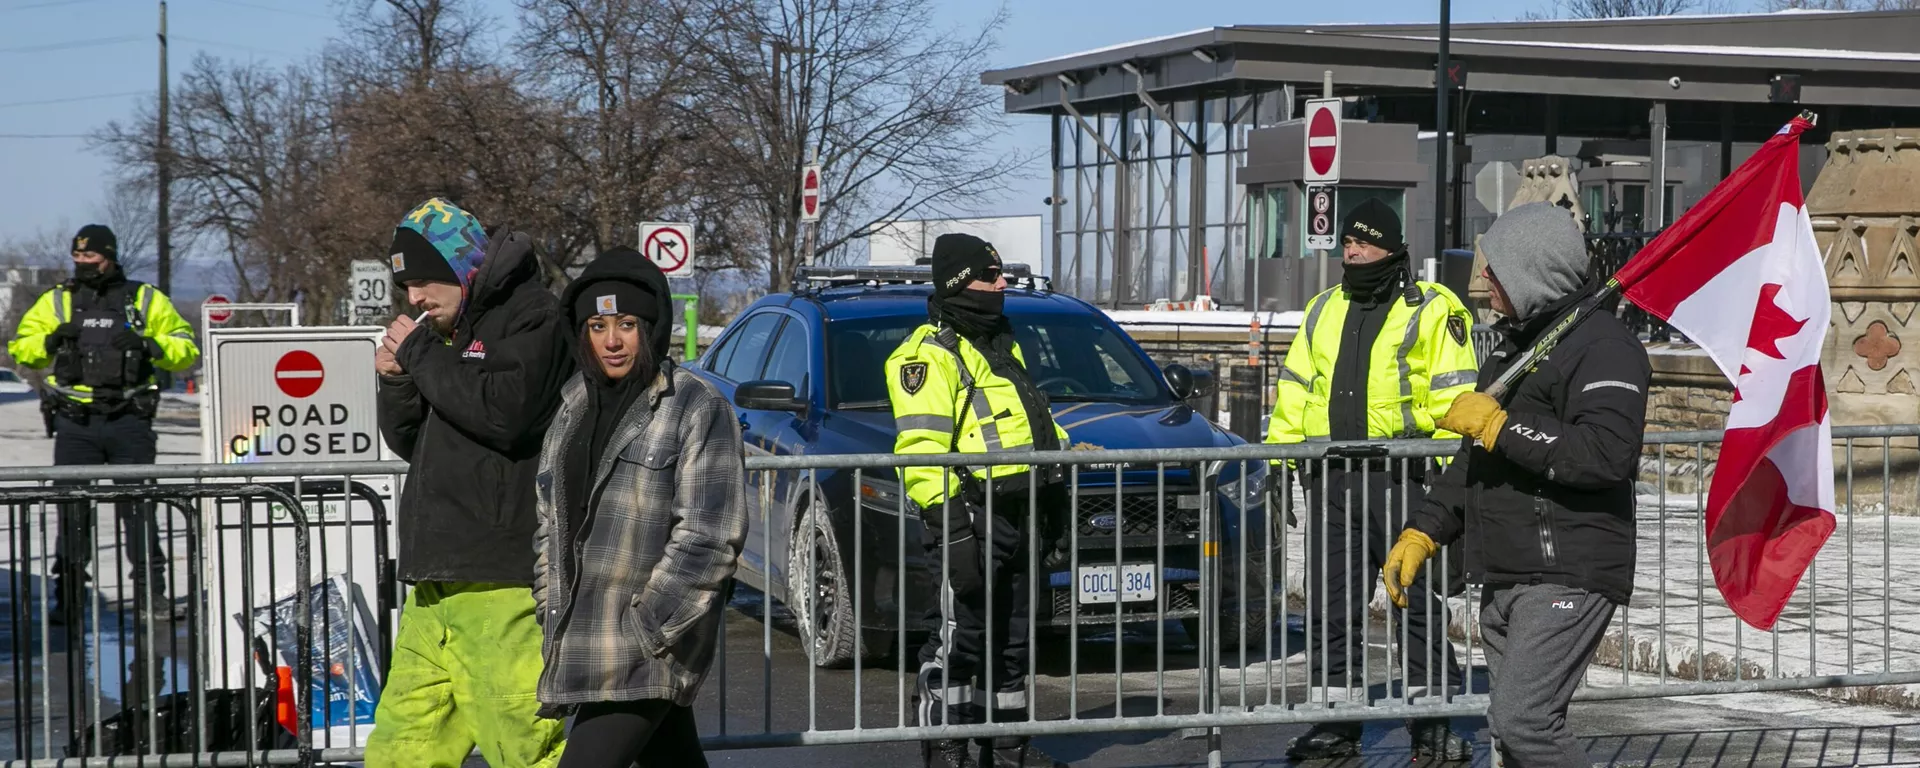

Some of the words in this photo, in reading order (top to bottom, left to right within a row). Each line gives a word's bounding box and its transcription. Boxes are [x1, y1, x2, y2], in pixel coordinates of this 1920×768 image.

[359, 278, 386, 301] 30
[252, 403, 348, 427] ROAD
[230, 432, 372, 457] CLOSED
[1090, 462, 1130, 470] SETIA
[1082, 573, 1117, 593] CDCL
[1126, 571, 1151, 591] 384
[1551, 599, 1574, 609] FILA
